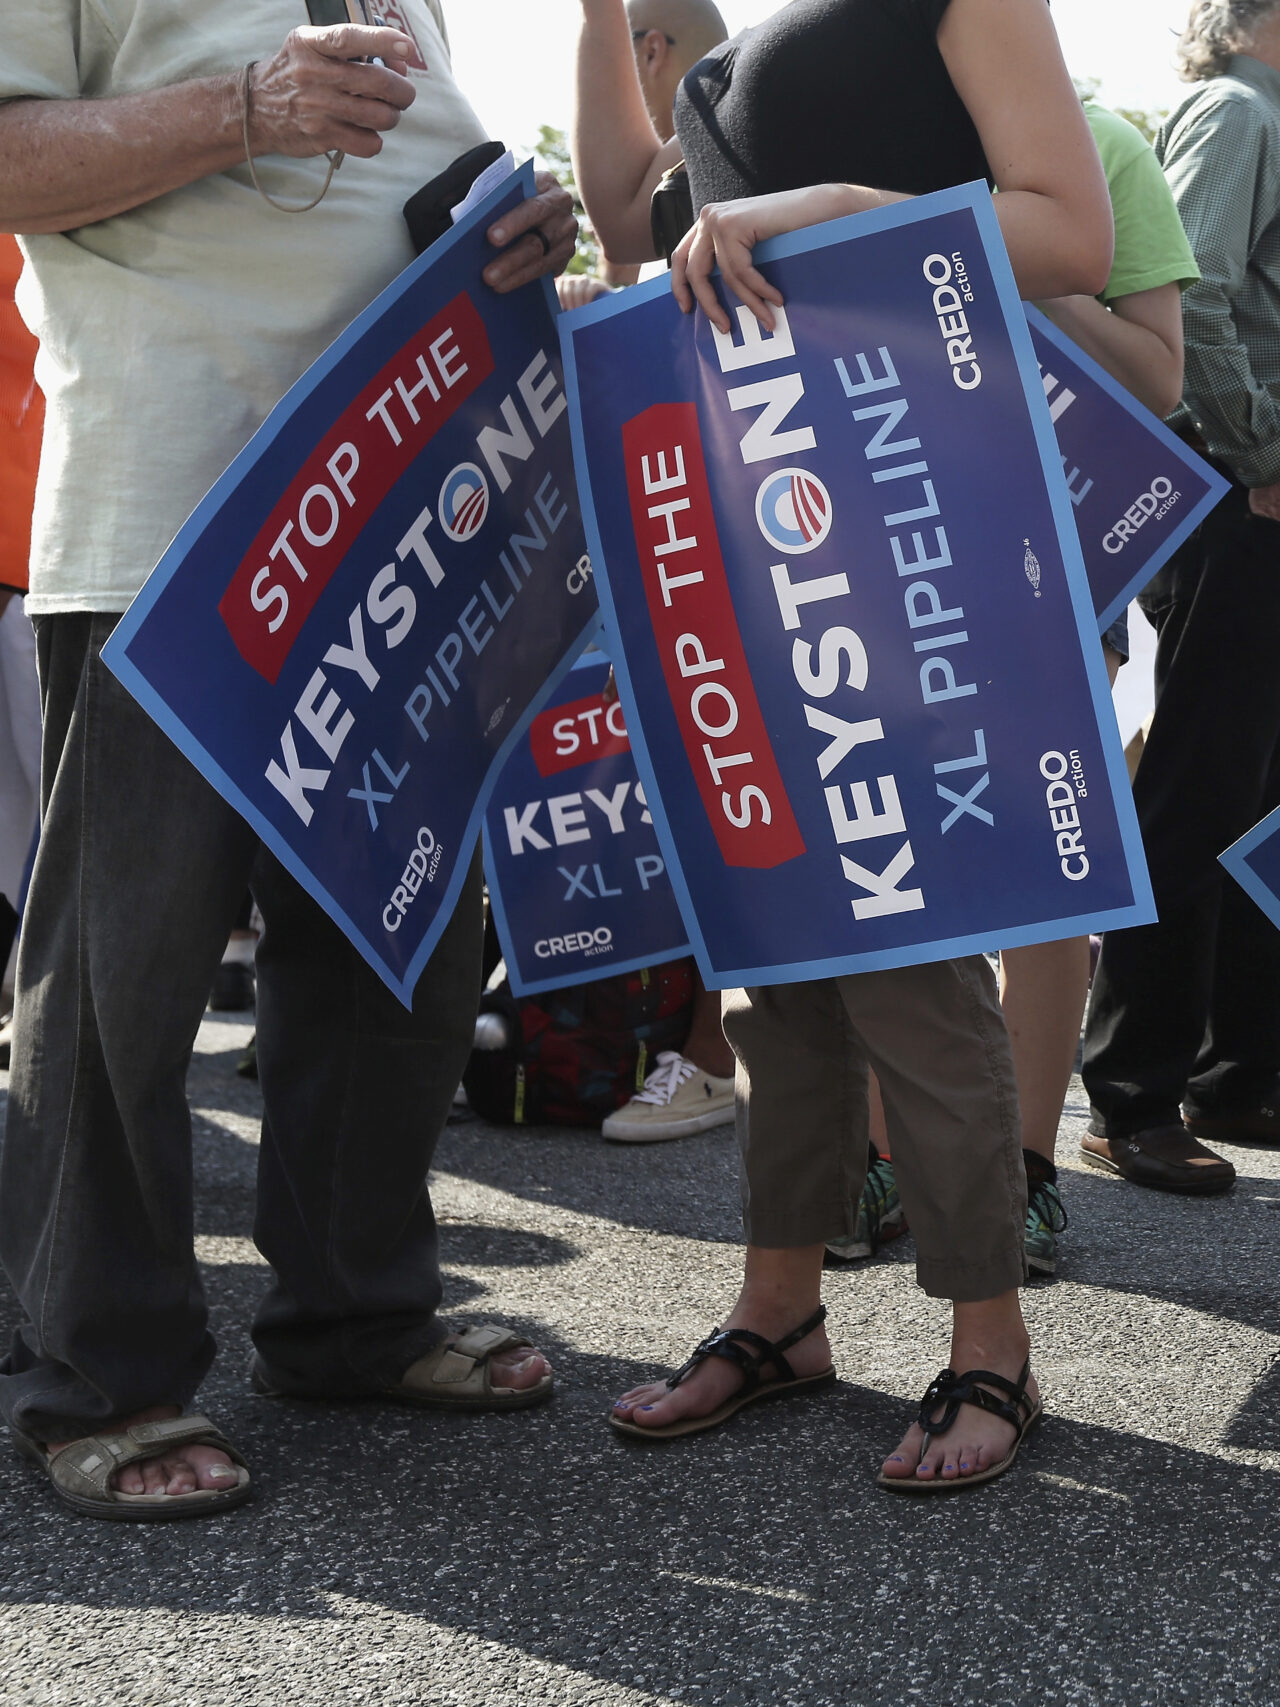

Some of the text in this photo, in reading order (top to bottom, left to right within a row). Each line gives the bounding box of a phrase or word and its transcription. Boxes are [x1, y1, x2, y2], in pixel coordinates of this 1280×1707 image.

[922, 253, 982, 391] CREDO
[951, 250, 977, 304] action
[249, 327, 469, 634] STOP THE
[1102, 476, 1173, 554] CREDO
[1154, 490, 1182, 521] action
[265, 349, 568, 828] KEYSTONE
[708, 302, 925, 921] KEYSTONE
[833, 345, 996, 837] XL PIPELINE
[346, 471, 568, 832] XL PIPELINE
[641, 444, 772, 829] STOP THE
[552, 701, 629, 756] STO
[1068, 748, 1088, 799] action
[1038, 749, 1090, 882] CREDO
[382, 825, 435, 933] CREDO
[425, 842, 444, 883] action
[556, 864, 622, 901] XL
[534, 927, 612, 958] CREDO
[584, 943, 613, 957] action
